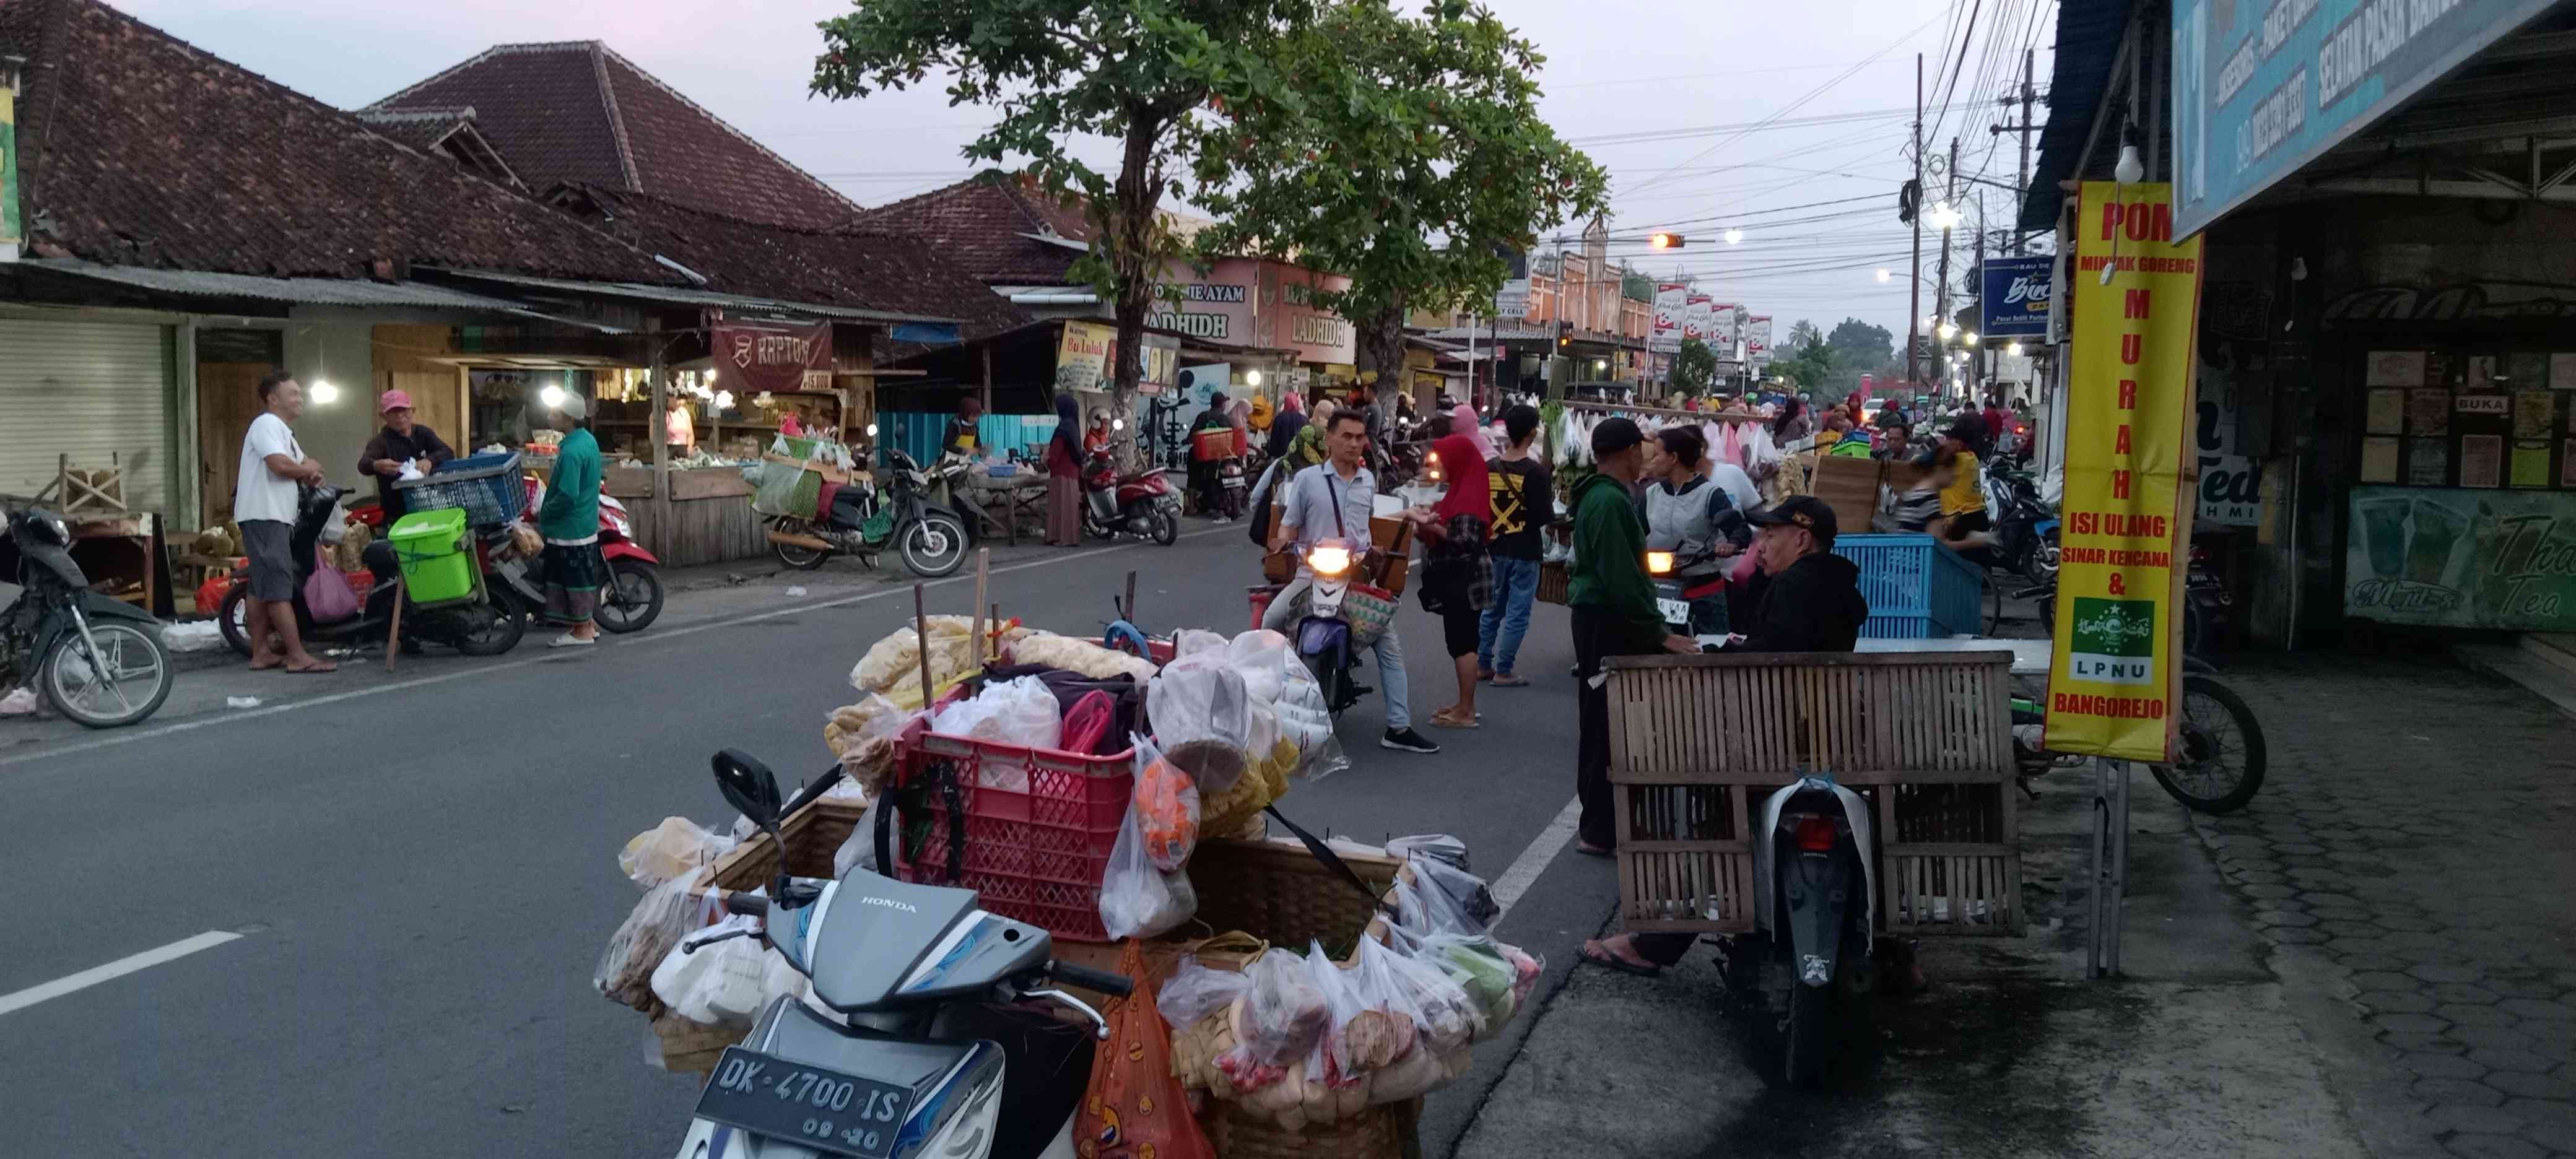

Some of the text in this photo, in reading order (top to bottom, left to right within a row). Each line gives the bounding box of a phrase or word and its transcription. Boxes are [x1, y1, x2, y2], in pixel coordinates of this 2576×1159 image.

[2081, 256, 2195, 274] MINAK GORENG
[1206, 285, 1245, 303] AYAM
[1143, 311, 1229, 339] ADHIDH
[1291, 313, 1346, 347] LADHIDH
[757, 335, 810, 367] RAPTOR
[1068, 337, 1079, 352] Bu
[2458, 399, 2504, 409] BUKA
[2069, 512, 2166, 538] ISI ULANG
[2061, 547, 2170, 568] SINAR KENCANA
[2108, 573, 2126, 596] &
[2076, 661, 2145, 679] LPNU
[2053, 693, 2164, 719] BANGOREJO
[861, 896, 917, 914] HONDA
[719, 1059, 901, 1122] DK 4700 IS
[802, 1118, 880, 1150] 09 20
